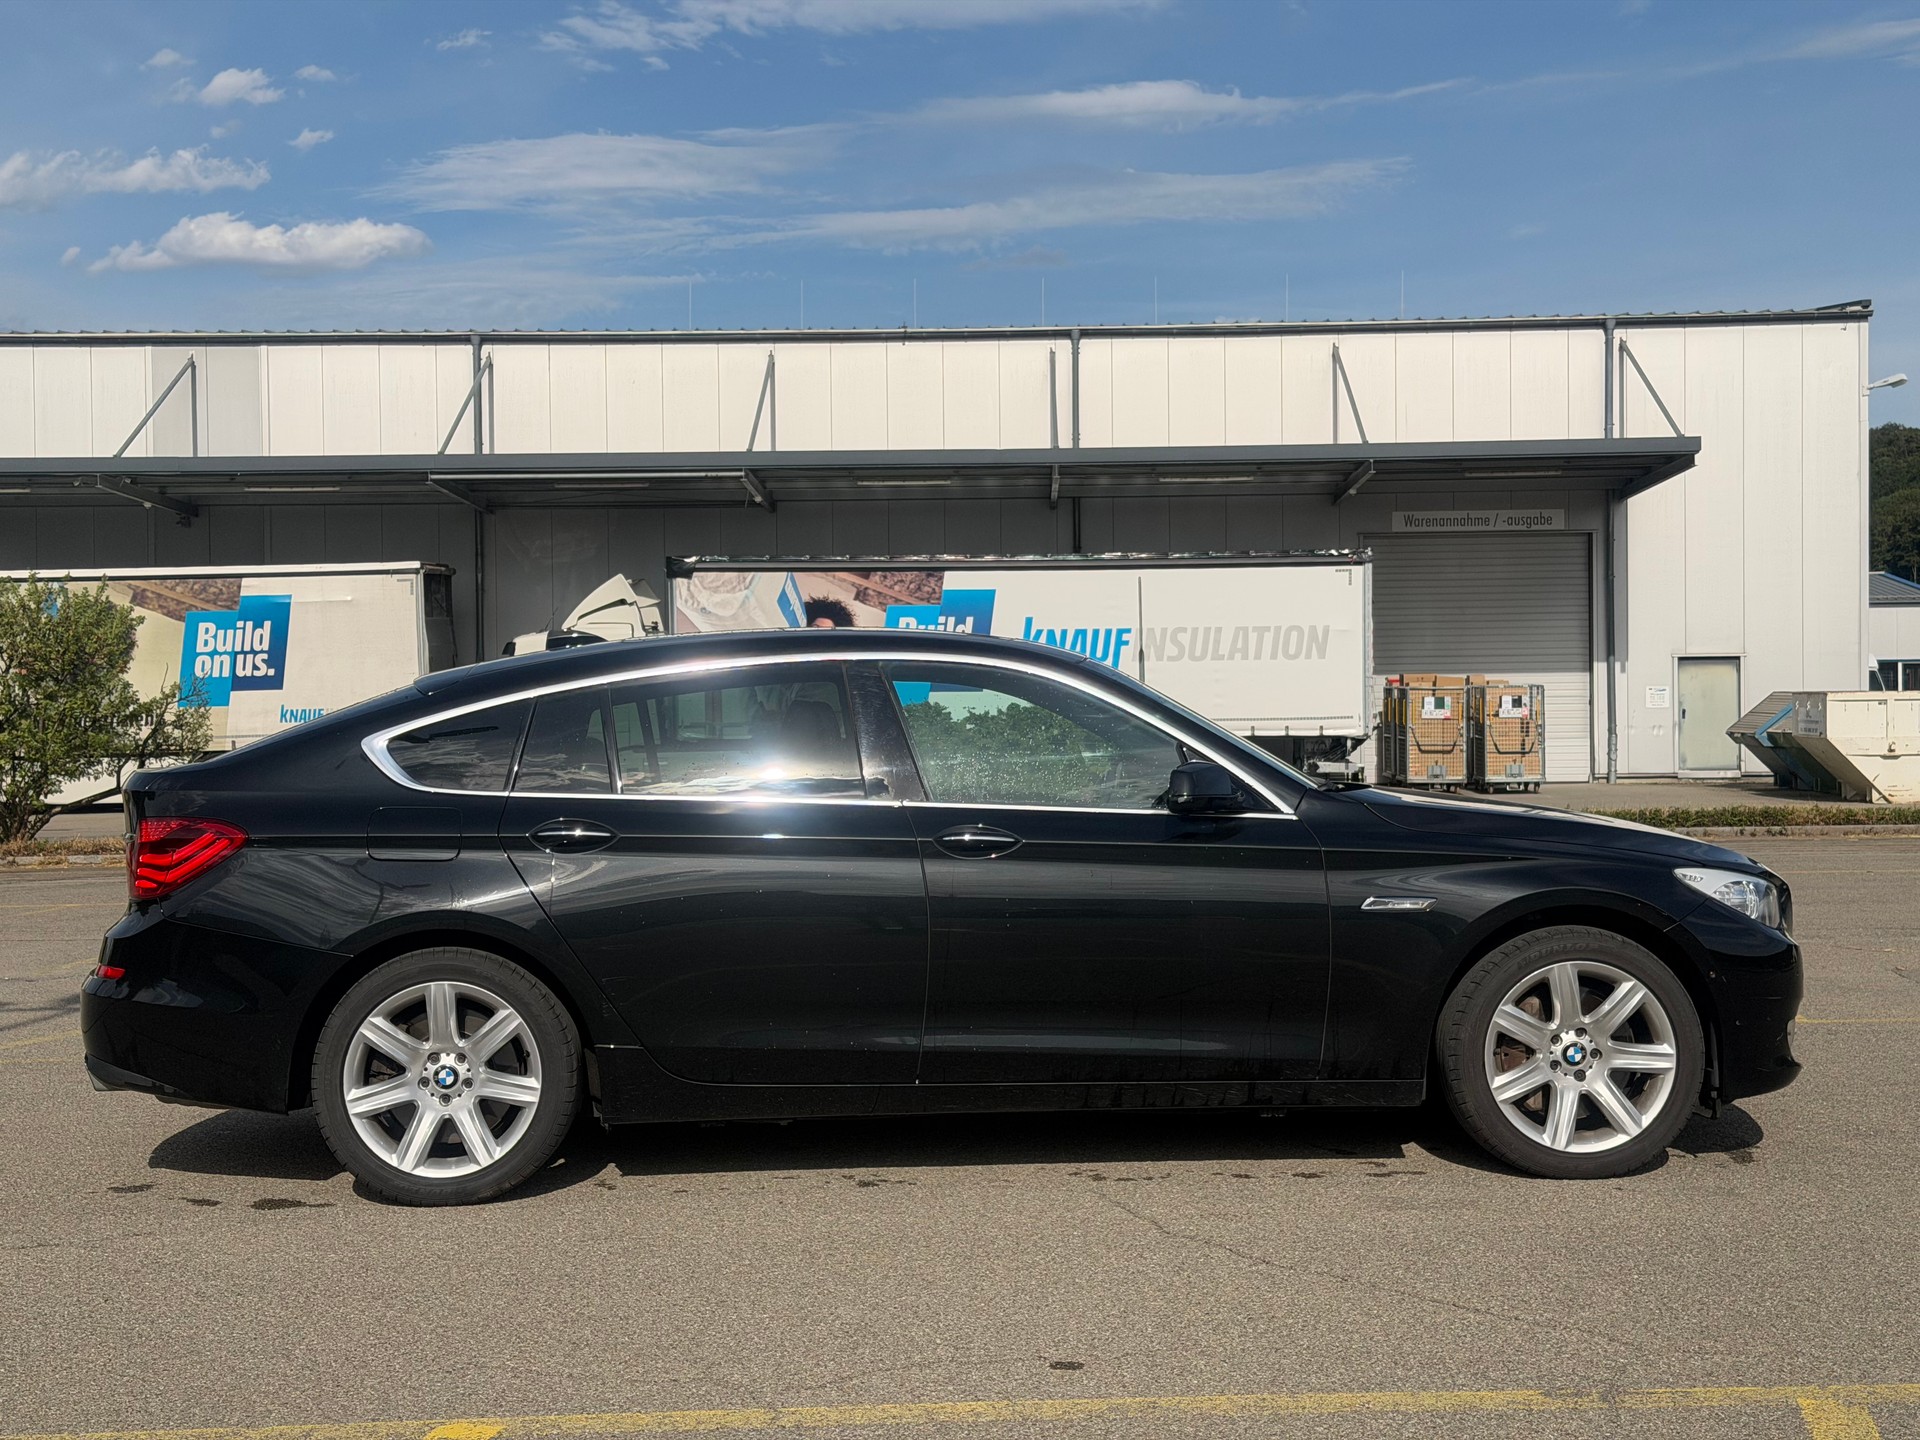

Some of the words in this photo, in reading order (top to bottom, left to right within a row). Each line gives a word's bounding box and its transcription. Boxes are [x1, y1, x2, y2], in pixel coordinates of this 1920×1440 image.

[1403, 512, 1490, 528] Warenannahme
[1502, 511, 1553, 529] -ausgabe
[195, 620, 272, 653] Build
[1131, 624, 1331, 663] INSULATION
[194, 654, 231, 678] on
[235, 653, 275, 677] us.
